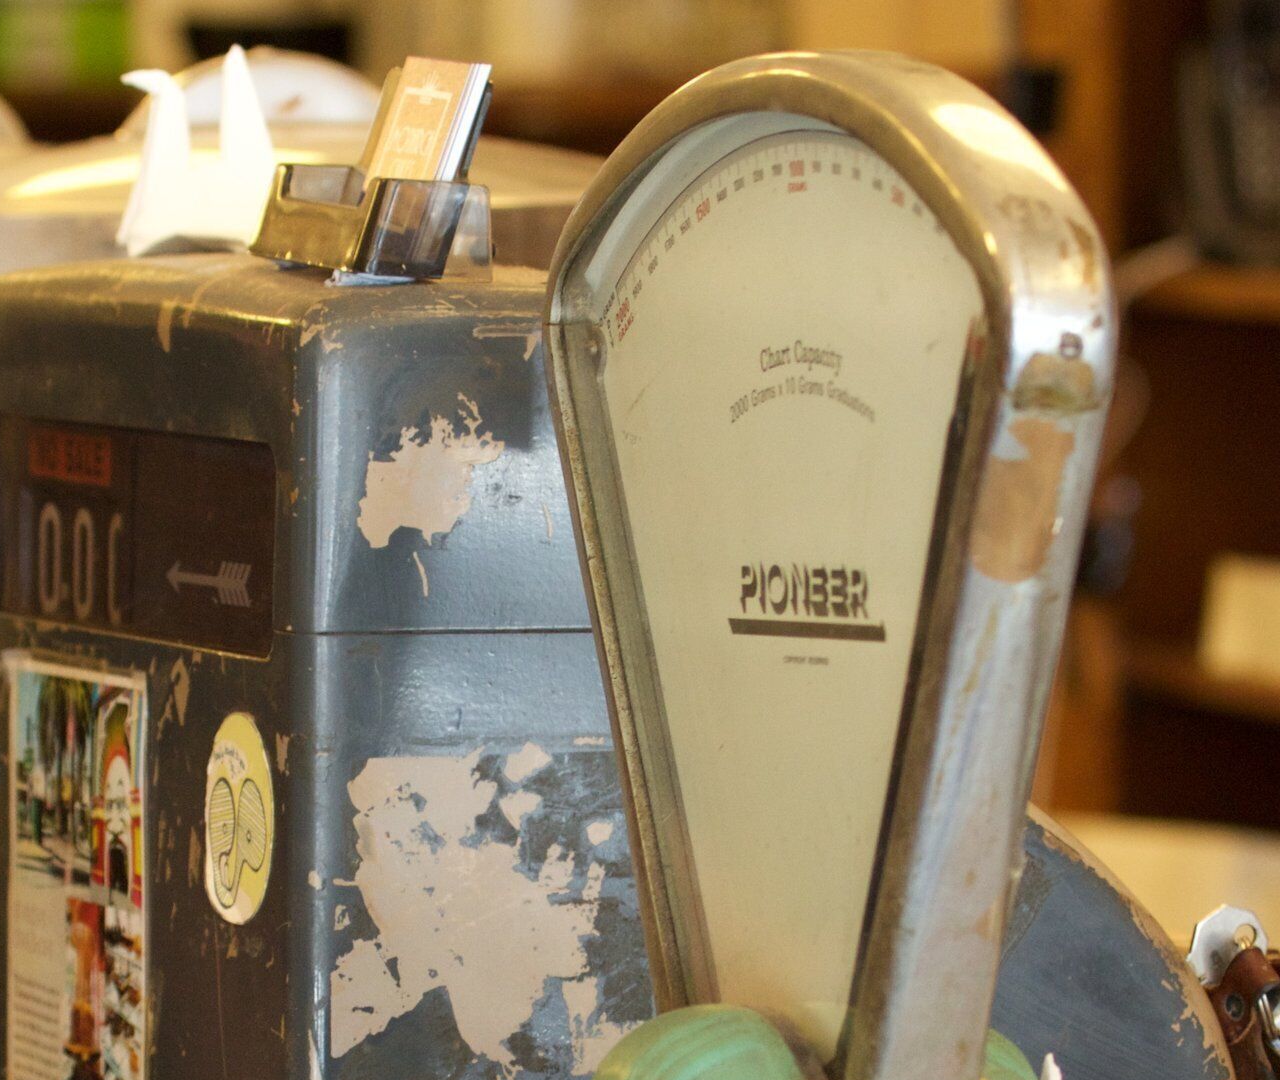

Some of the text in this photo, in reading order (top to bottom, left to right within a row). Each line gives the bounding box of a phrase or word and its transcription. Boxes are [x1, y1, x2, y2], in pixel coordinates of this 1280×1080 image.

[760, 339, 843, 377] Chart Capacity
[740, 561, 868, 618] PIONEER
